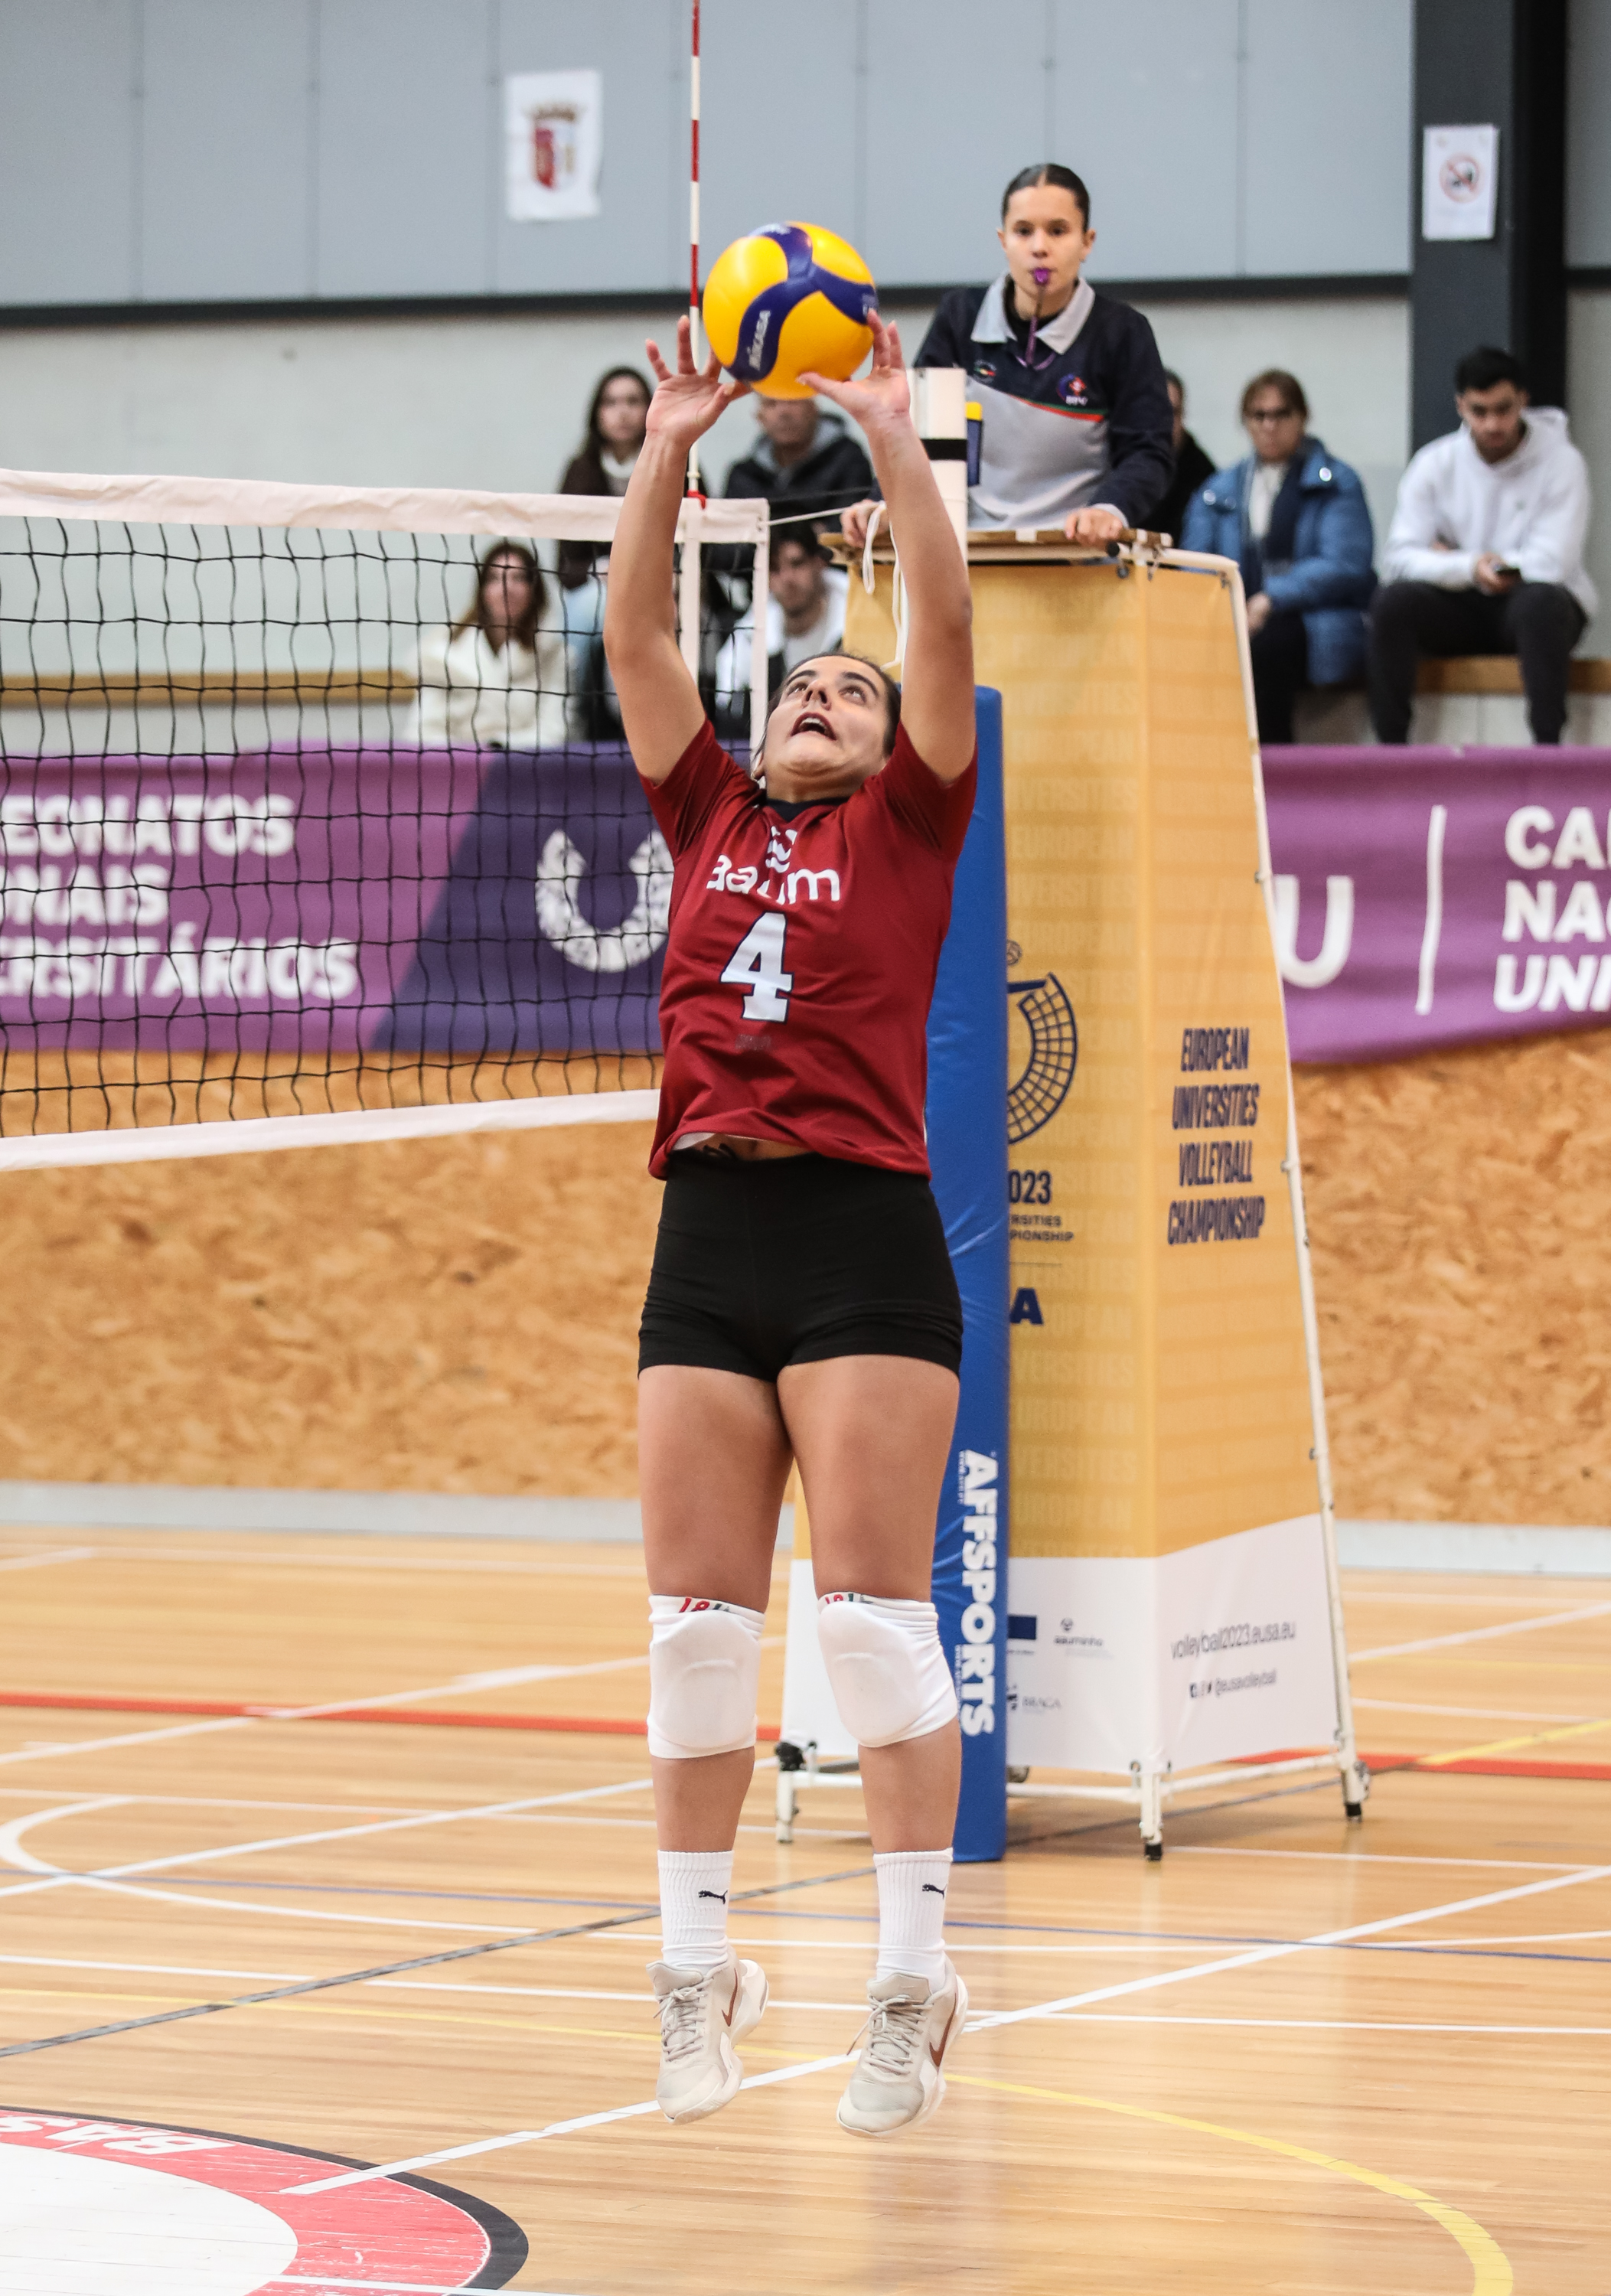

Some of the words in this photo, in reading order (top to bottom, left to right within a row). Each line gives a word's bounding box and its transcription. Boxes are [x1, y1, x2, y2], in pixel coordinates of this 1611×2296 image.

[1505, 805, 1611, 869] CA
[0, 863, 170, 926] NAIS
[1502, 880, 1611, 943] NA
[1273, 874, 1355, 989] U
[719, 911, 794, 1024] 4
[1181, 1027, 1249, 1071] EUROPEAN
[1172, 1083, 1260, 1130] UNIVERSITIES
[1179, 1140, 1252, 1186] VOLLEYBALL
[1168, 1195, 1265, 1245] CHAMPIONSHIP
[960, 1449, 999, 1737] AFFSPORTS
